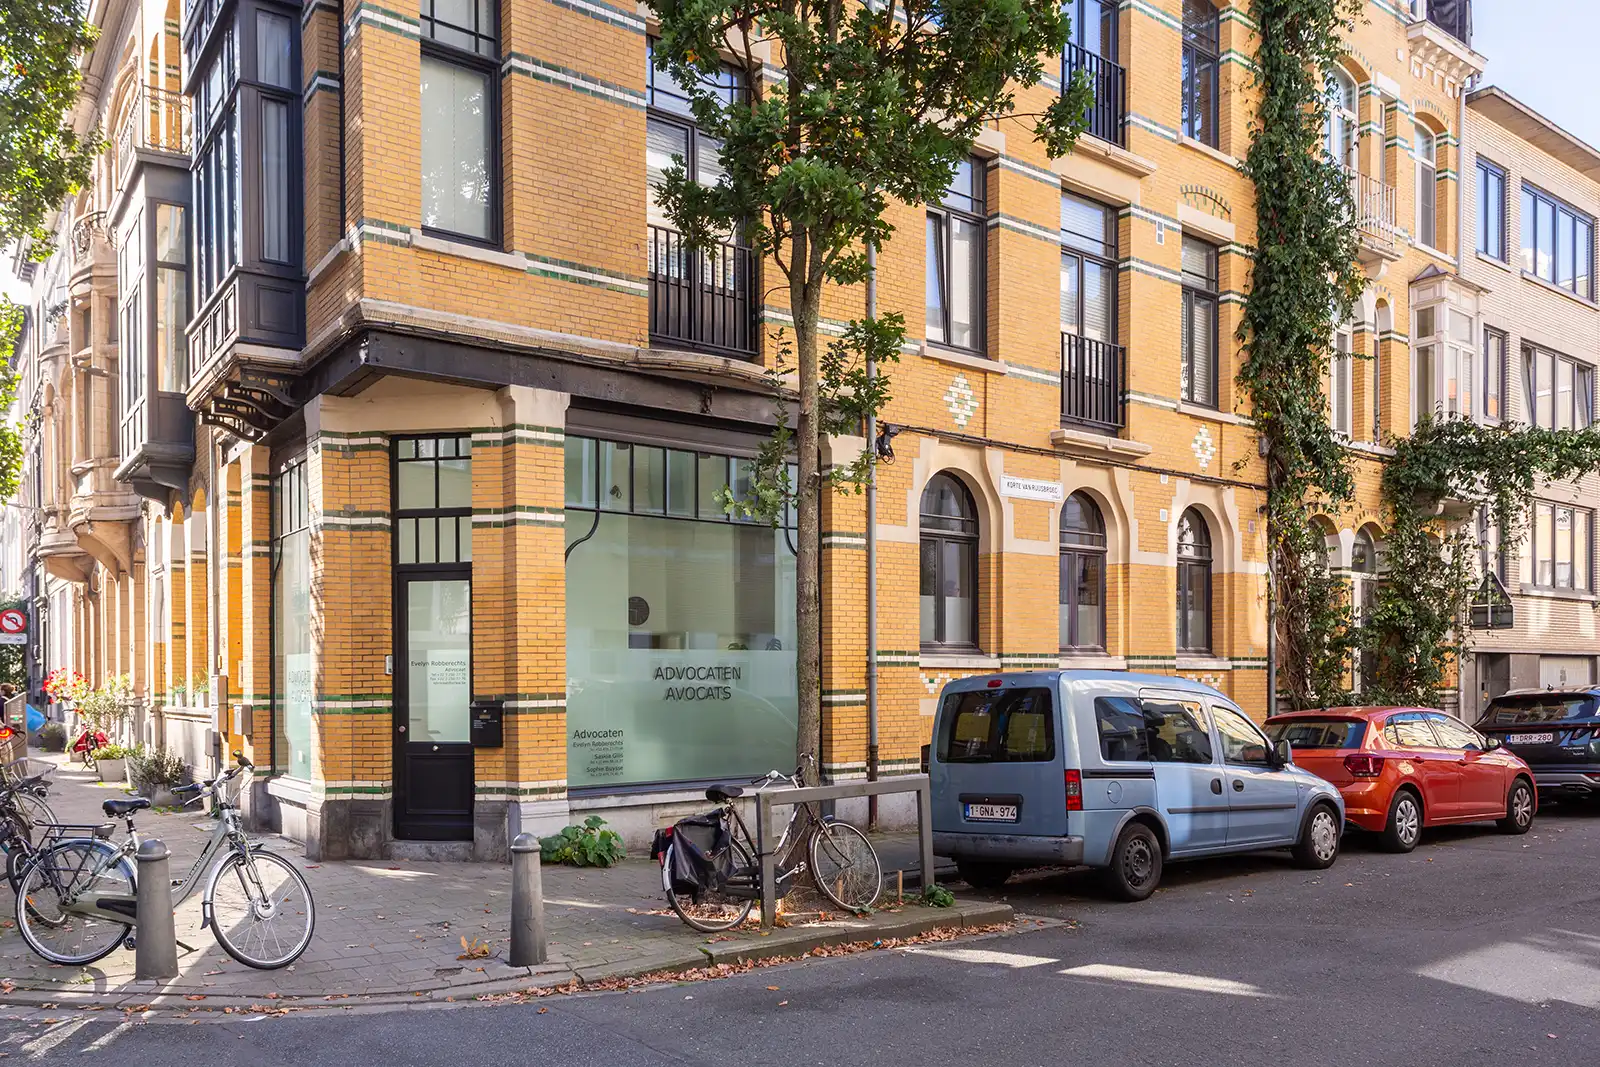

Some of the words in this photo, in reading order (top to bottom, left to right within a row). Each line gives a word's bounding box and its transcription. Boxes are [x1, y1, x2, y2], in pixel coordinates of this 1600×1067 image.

[1006, 481, 1021, 490] KORTE
[1022, 483, 1032, 491] VAN
[654, 666, 741, 681] ADVOCATEN
[664, 686, 732, 701] AVOCATS
[573, 729, 624, 739] Advocaten
[970, 805, 1016, 818] 1-GNA-974
